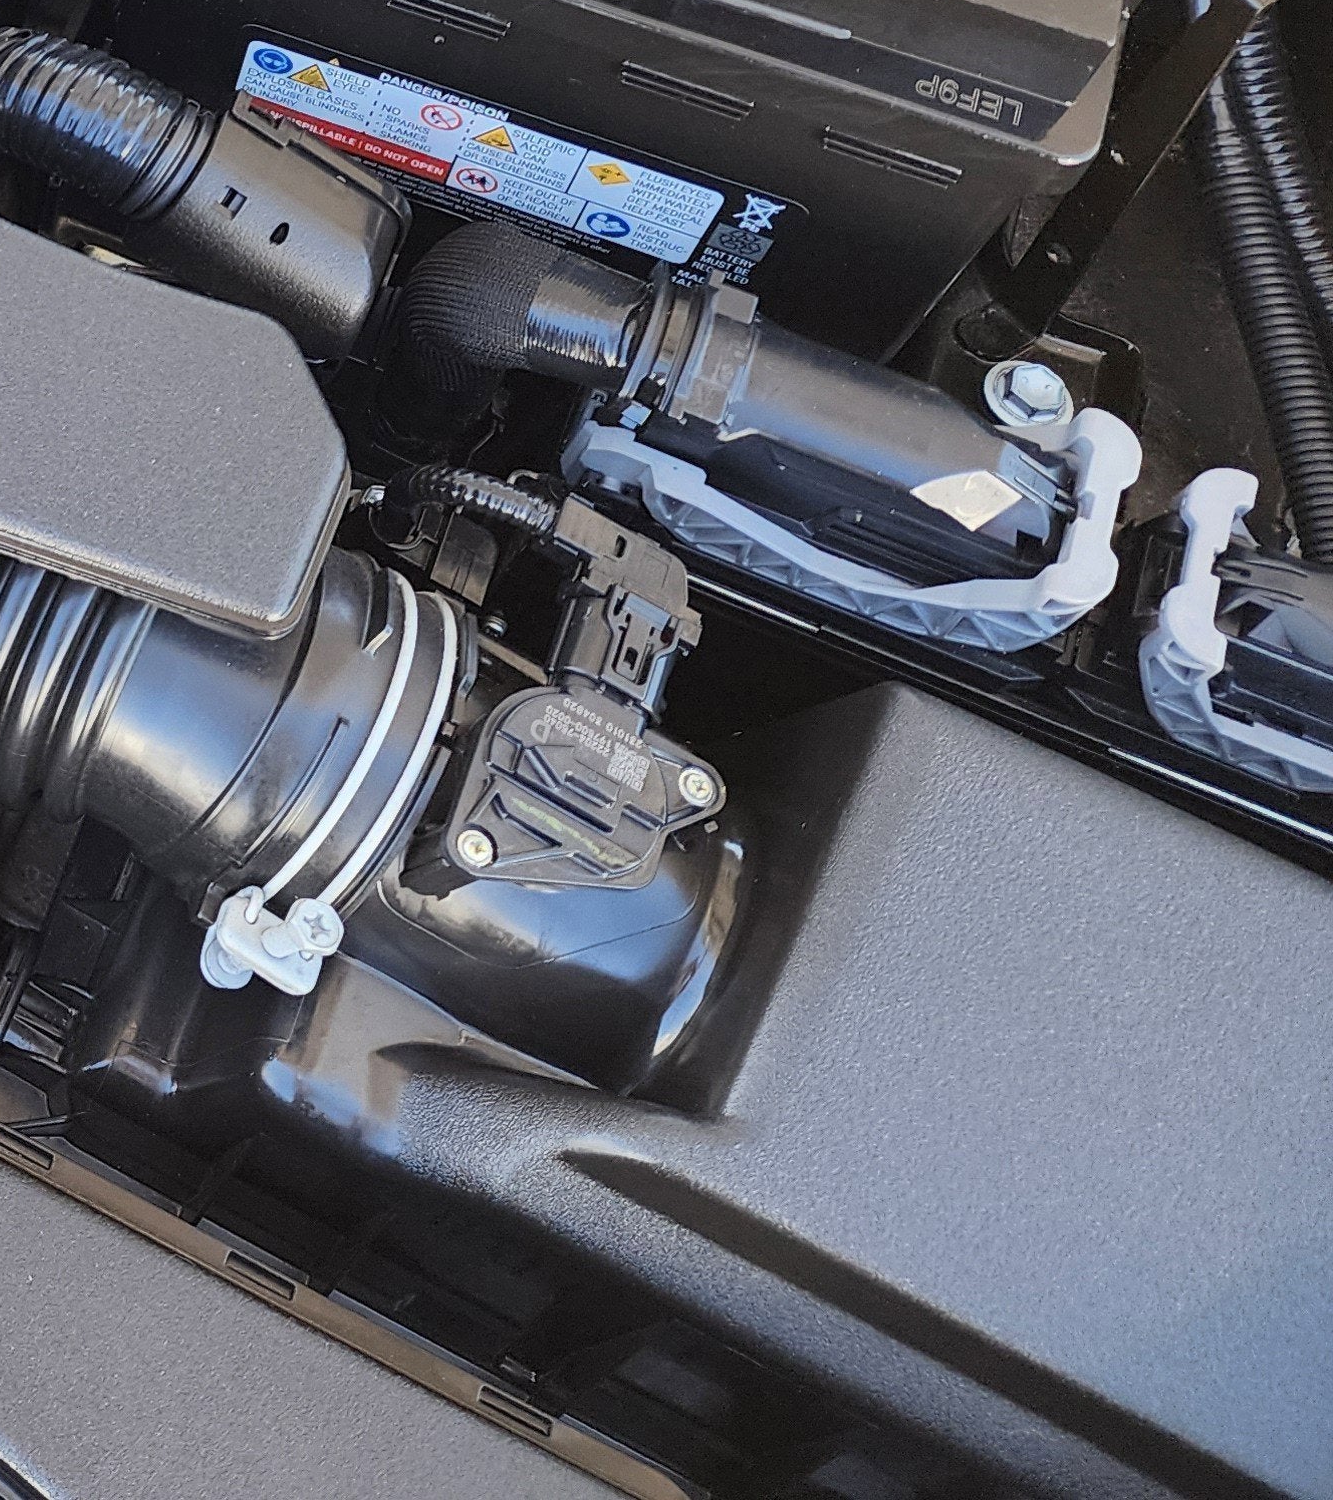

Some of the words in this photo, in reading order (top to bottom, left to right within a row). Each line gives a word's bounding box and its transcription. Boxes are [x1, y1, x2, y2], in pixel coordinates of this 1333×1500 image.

[246, 67, 314, 96] EXPLOSIVE
[315, 90, 358, 110] GASES
[325, 67, 371, 88] SHIELD
[244, 76, 266, 88] CAN
[267, 84, 301, 100] CAUSE
[304, 96, 364, 121] BLINDNESS
[377, 71, 510, 121] DANGER/POISON
[911, 68, 1026, 127] LEF9P
[381, 103, 401, 115] NO
[381, 122, 427, 142] FLAMES
[385, 114, 430, 134] SPARKS
[378, 130, 432, 153] SMOKING
[511, 128, 577, 156] SULFURIC
[519, 141, 551, 157] ACID
[363, 143, 381, 155] DO
[382, 149, 407, 163] NOT
[410, 158, 444, 175] OPEN
[462, 149, 479, 160] OR
[480, 155, 527, 176] SEVERE
[465, 141, 501, 158] CAUSE
[503, 154, 567, 181] BLINDNESS
[521, 151, 546, 165] CAN
[502, 178, 536, 195] KEEP
[538, 189, 558, 202] OUT
[559, 197, 576, 208] OF
[630, 186, 666, 204] WITH
[634, 178, 714, 210] IMMEDIATELY
[638, 170, 679, 189] FLUSH
[680, 184, 712, 200] EYES
[496, 193, 512, 204] OF
[499, 185, 523, 199] THE
[525, 194, 563, 212] REACH
[621, 202, 655, 218] HELP
[626, 194, 650, 208] GET
[651, 202, 704, 225] MEDICAL
[636, 223, 669, 239] READ
[700, 254, 733, 271] MUST
[733, 265, 750, 276] BE
[703, 246, 756, 269] BATTERY
[690, 260, 749, 285] RECLED
